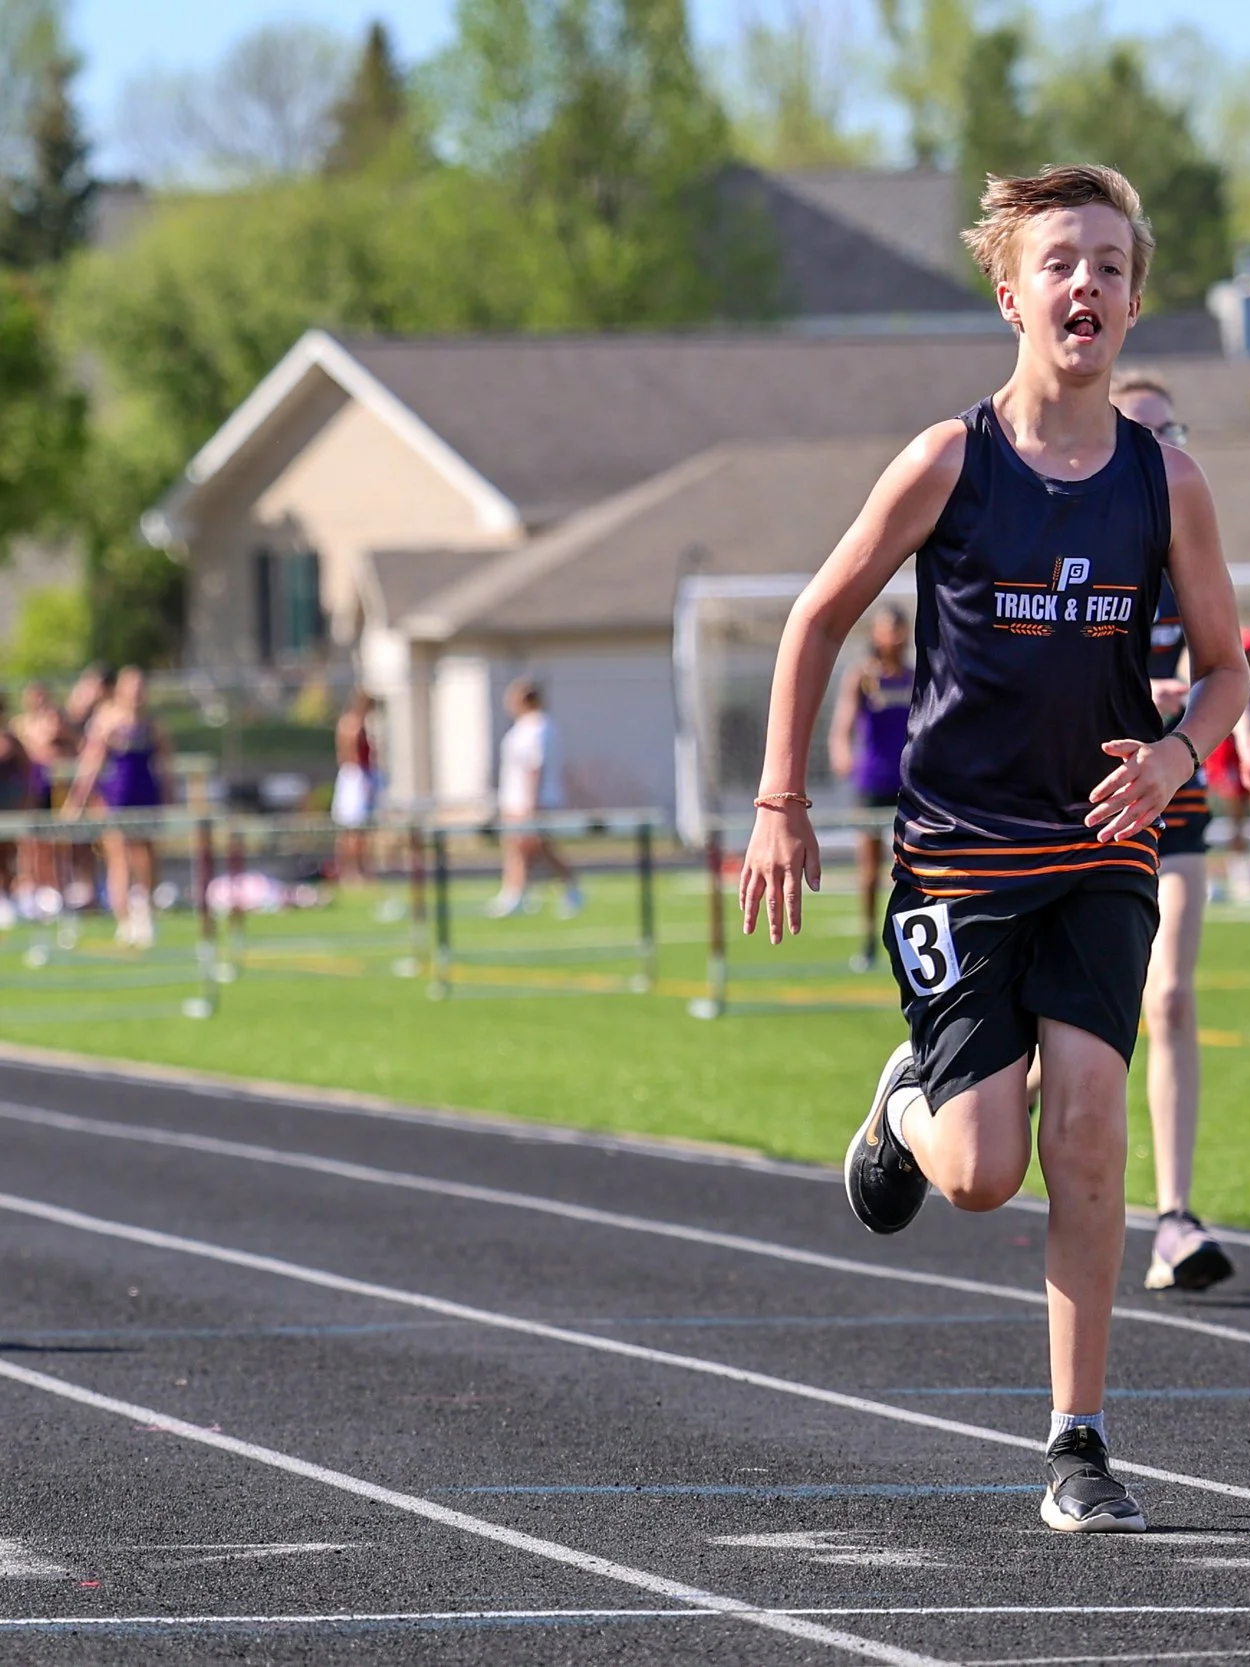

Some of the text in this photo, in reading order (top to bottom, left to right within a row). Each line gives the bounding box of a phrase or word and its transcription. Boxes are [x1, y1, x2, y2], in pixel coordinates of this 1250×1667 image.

[994, 592, 1132, 622] TRACK & FIELD
[903, 914, 947, 989] 3
